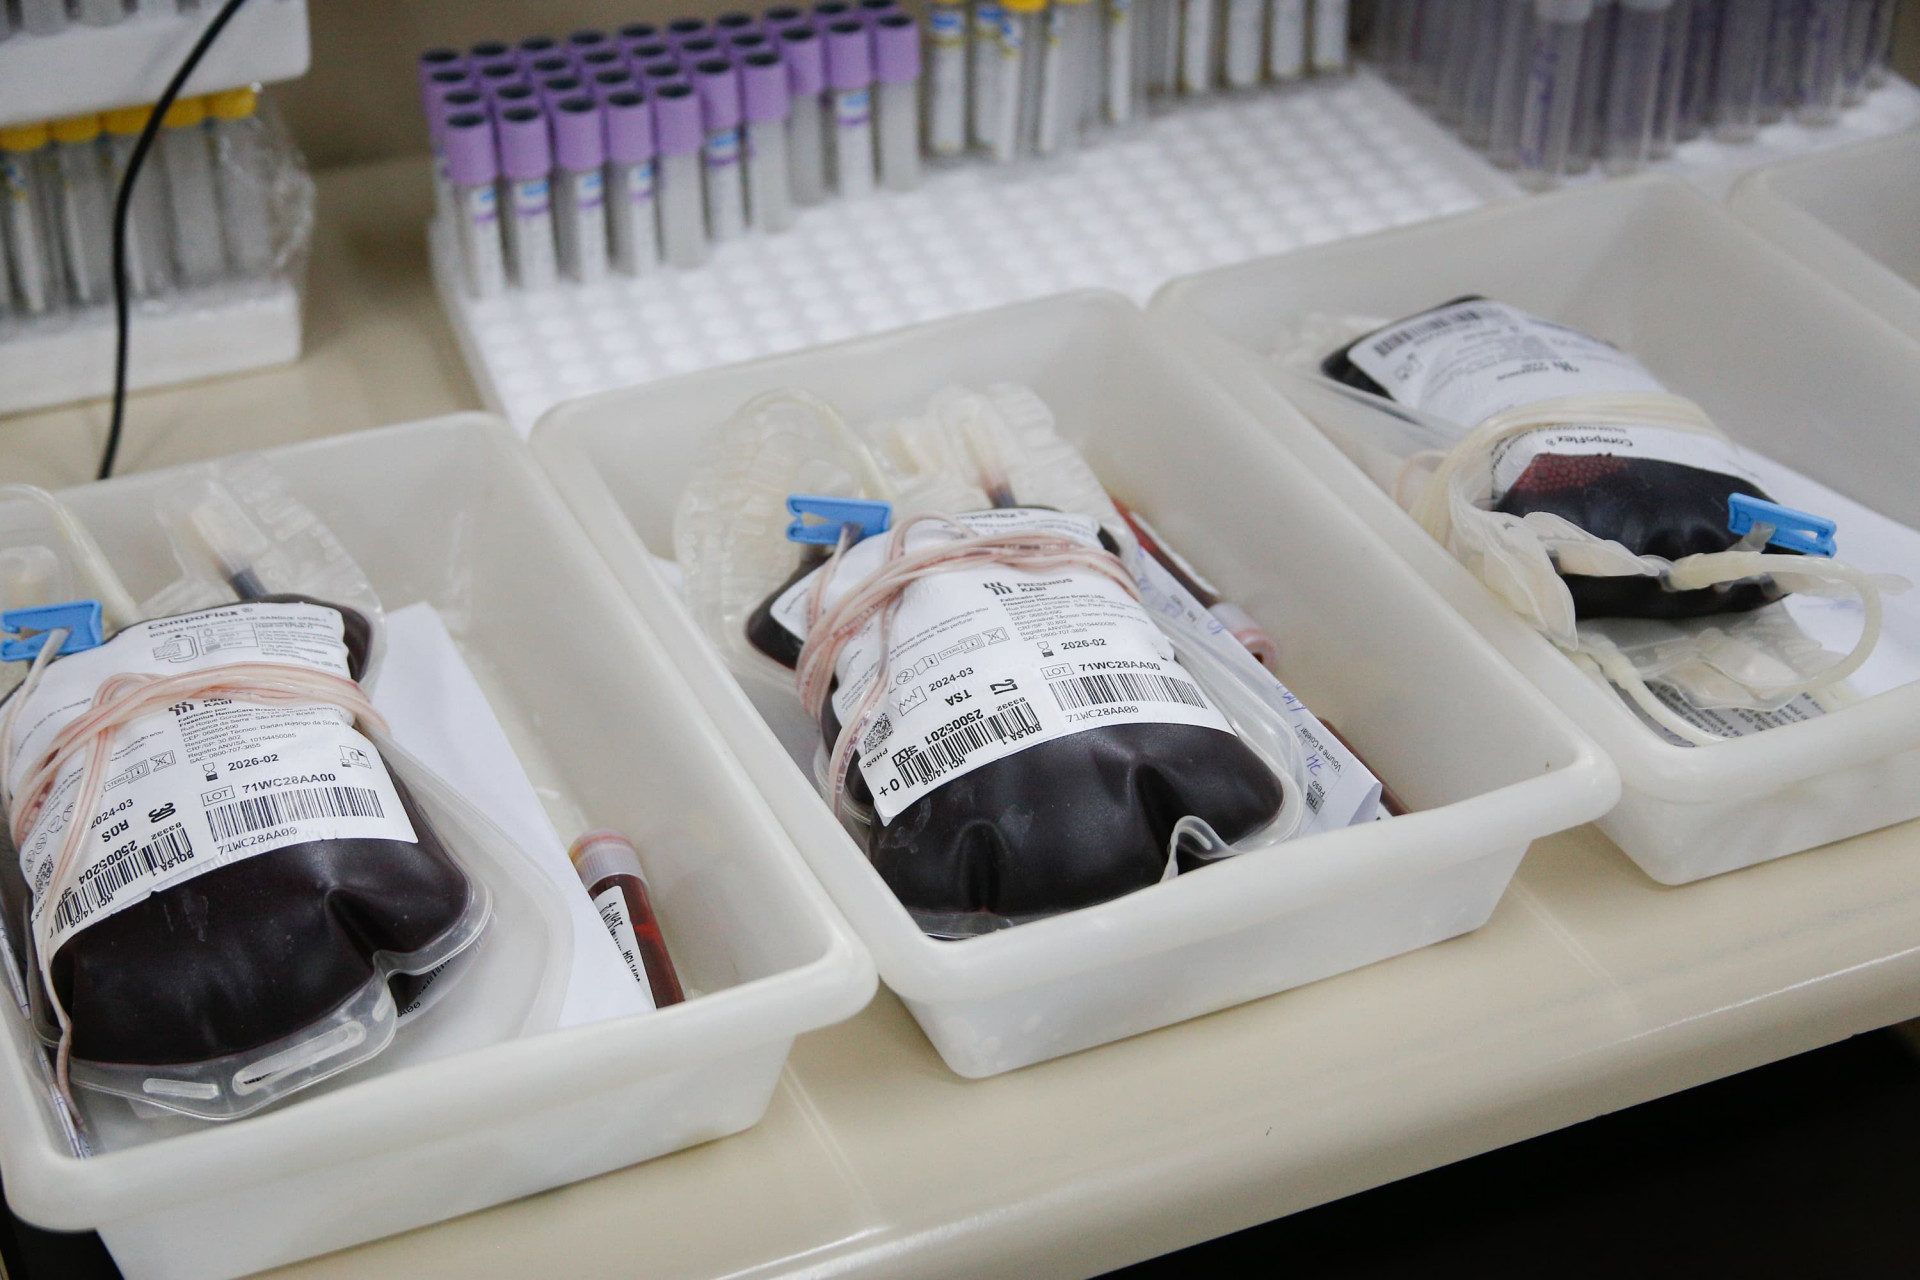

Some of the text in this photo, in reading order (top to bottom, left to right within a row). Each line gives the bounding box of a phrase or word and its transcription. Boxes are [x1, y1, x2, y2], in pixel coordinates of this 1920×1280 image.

[1017, 578, 1072, 588] FRESENIUS
[148, 610, 238, 630] CompoFlex
[1061, 638, 1108, 650] 2026-02
[1046, 660, 1161, 677] LOT 71WC28AA00
[928, 667, 974, 692] 2024-03
[944, 690, 972, 707] TSA
[178, 707, 216, 723] Fabricado
[179, 714, 214, 727] Fresenius
[215, 708, 253, 717] HemoCare
[1066, 706, 1139, 722] 71WC28AA00
[924, 709, 984, 745] 25005201
[1010, 723, 1043, 741] BOLSA
[1300, 726, 1320, 748] Coletar
[188, 746, 217, 759] Registro
[1321, 749, 1342, 772] Volume
[228, 753, 280, 772] 2026-02
[106, 774, 130, 788] STERILE
[923, 766, 947, 786] 14/06
[205, 772, 337, 803] LOT 71WC28AA00
[1311, 780, 1326, 798] Peso
[102, 819, 129, 843] ROS
[216, 826, 298, 856] 71WC28AA00
[78, 840, 138, 885] 25005204
[159, 850, 195, 872] BOLSA
[70, 906, 95, 928] 14/06
